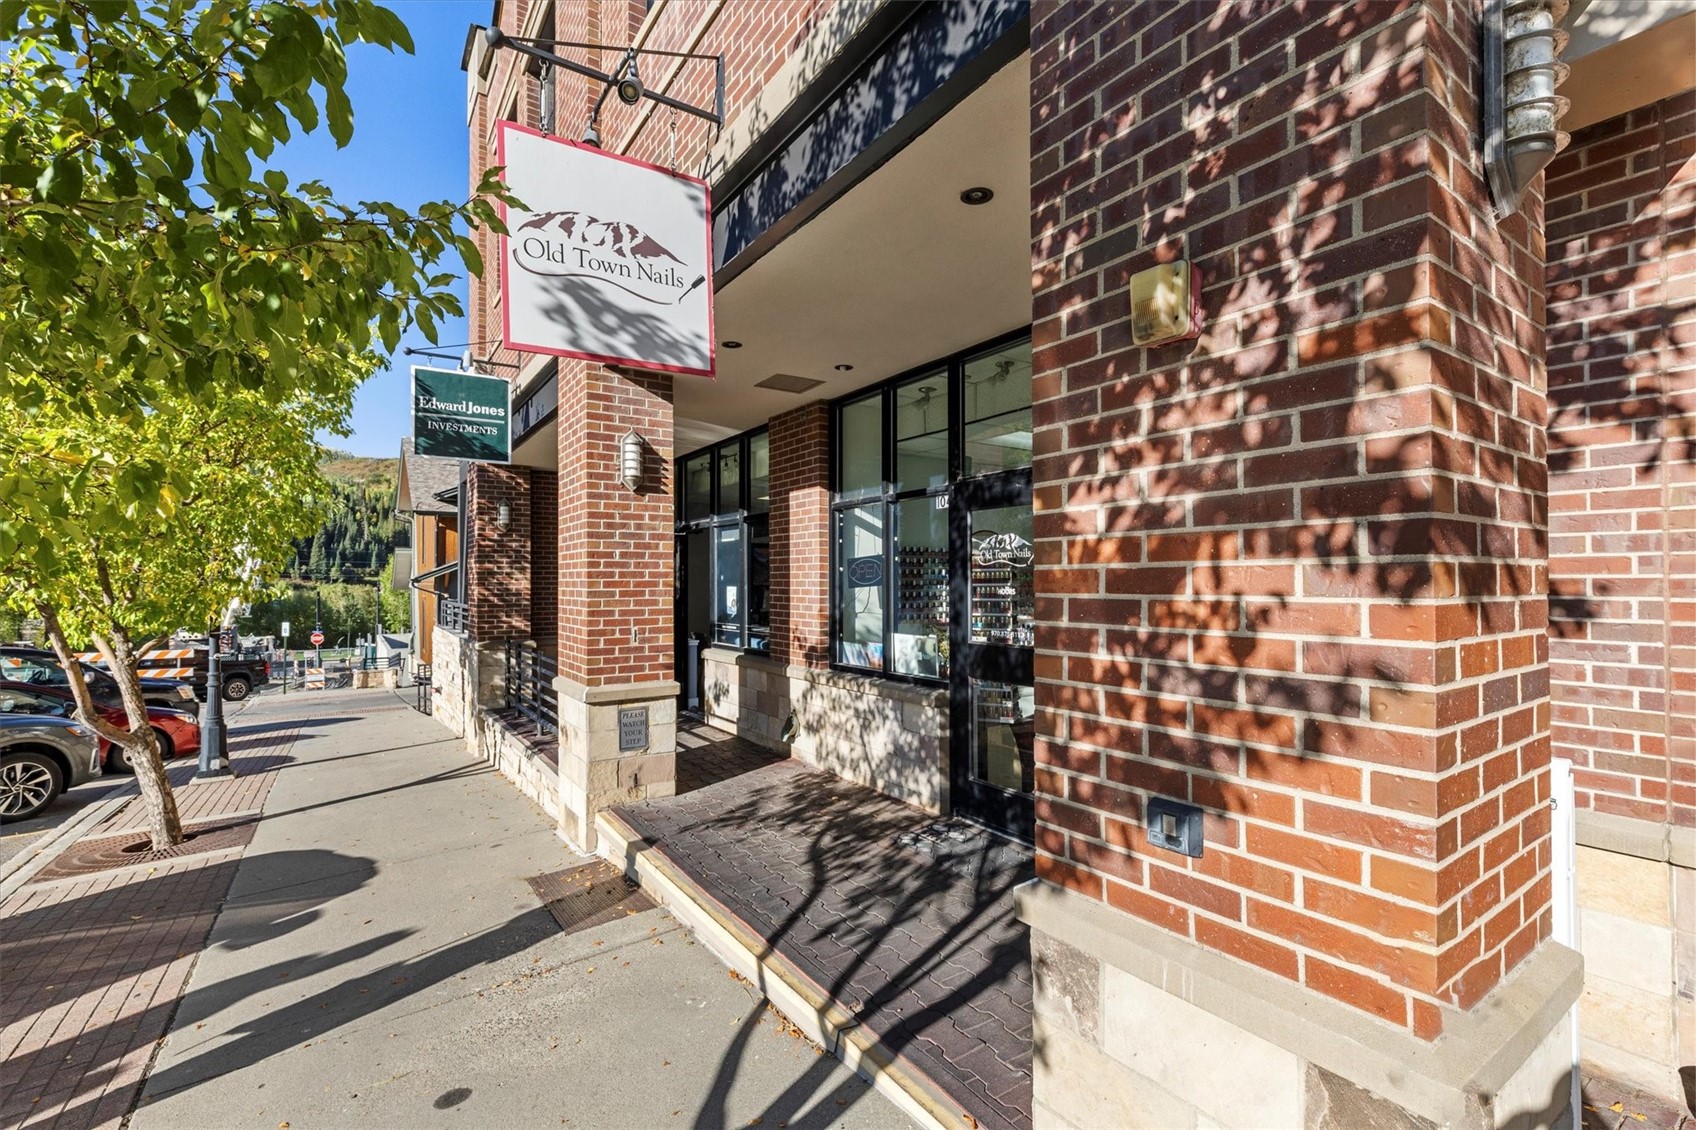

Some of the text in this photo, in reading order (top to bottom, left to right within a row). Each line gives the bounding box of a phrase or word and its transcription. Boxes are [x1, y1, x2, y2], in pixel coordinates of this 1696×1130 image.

[523, 237, 684, 288] Old Town Nails
[427, 420, 498, 435] INVESTMENTS
[980, 547, 1031, 559] Old Town Nails
[850, 563, 882, 579] OPEN
[622, 711, 645, 719] PLEASE
[622, 719, 645, 728] WATCH
[624, 729, 643, 737] YOUR
[625, 738, 642, 746] STEP
